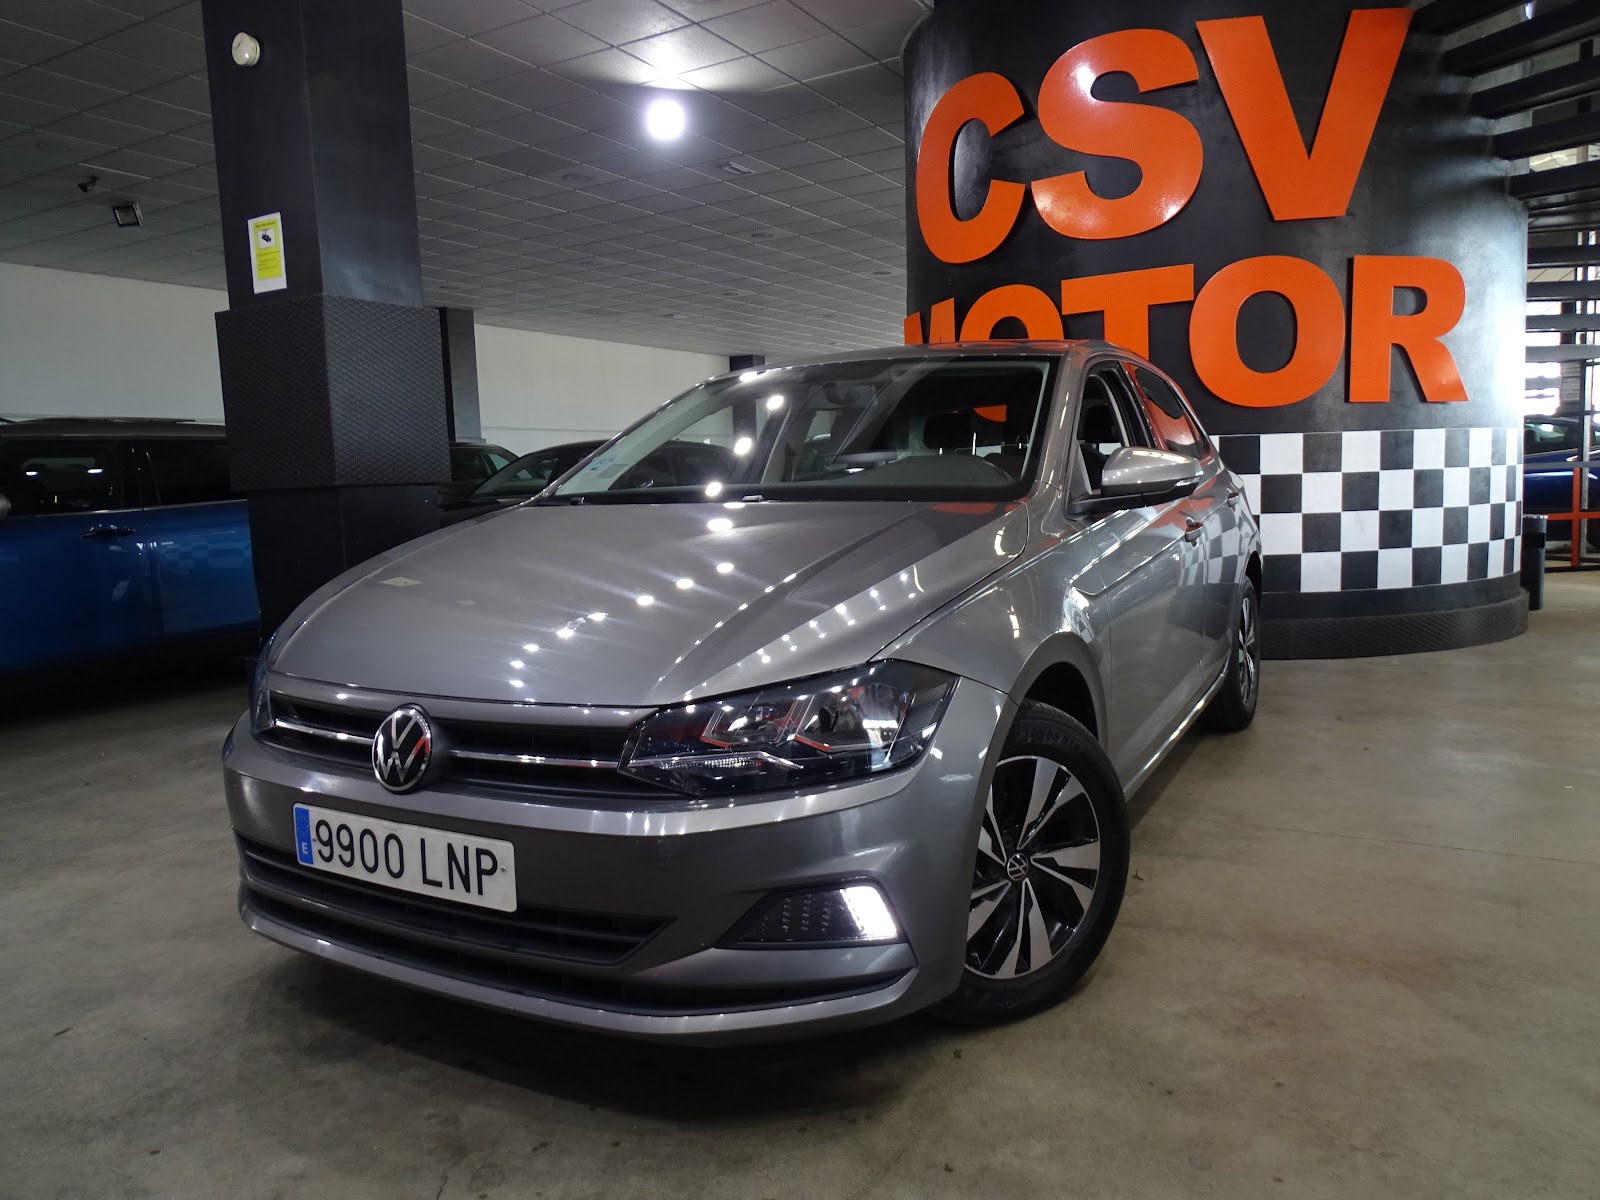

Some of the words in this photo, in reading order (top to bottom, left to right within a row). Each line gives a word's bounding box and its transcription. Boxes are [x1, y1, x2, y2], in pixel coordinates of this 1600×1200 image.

[916, 7, 1415, 264] CSV
[301, 841, 309, 855] E
[315, 819, 405, 880] 9900
[420, 838, 498, 896] LNP
